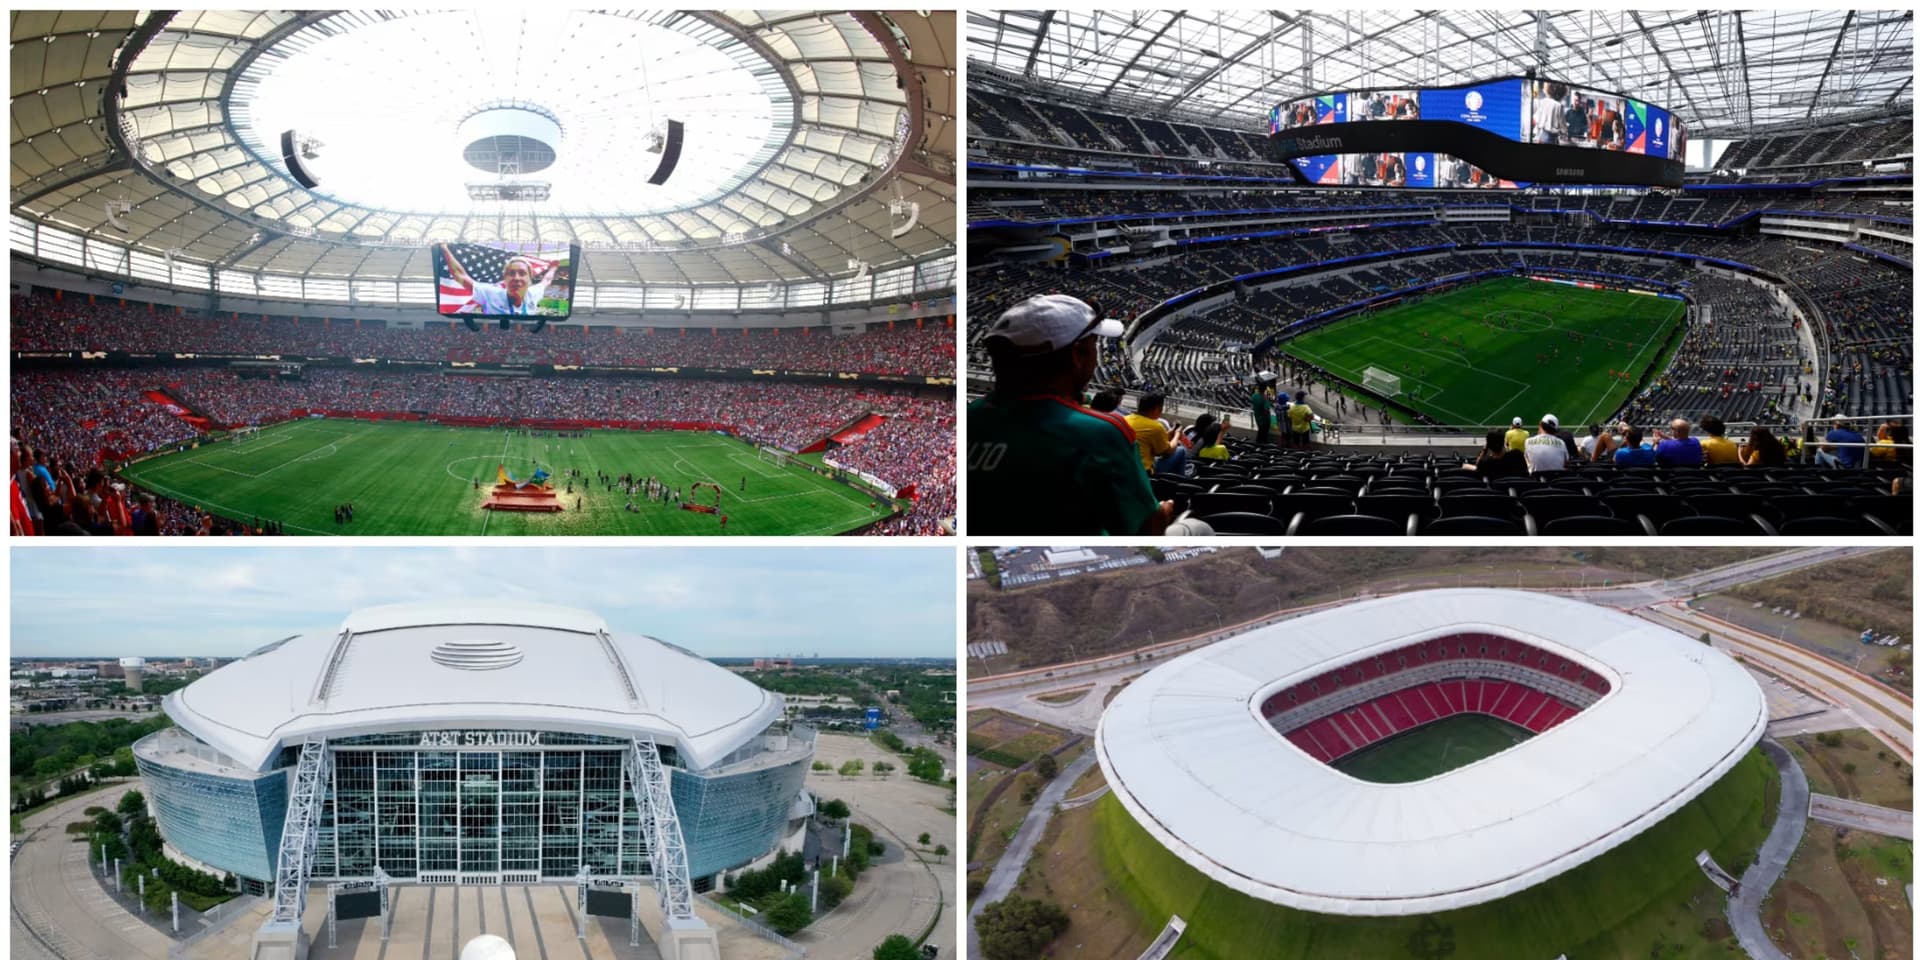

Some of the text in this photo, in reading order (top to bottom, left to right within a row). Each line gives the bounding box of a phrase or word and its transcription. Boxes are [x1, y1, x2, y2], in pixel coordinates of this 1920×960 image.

[1296, 134, 1343, 151] Stadium
[420, 731, 541, 746] AT&T STADIUM
